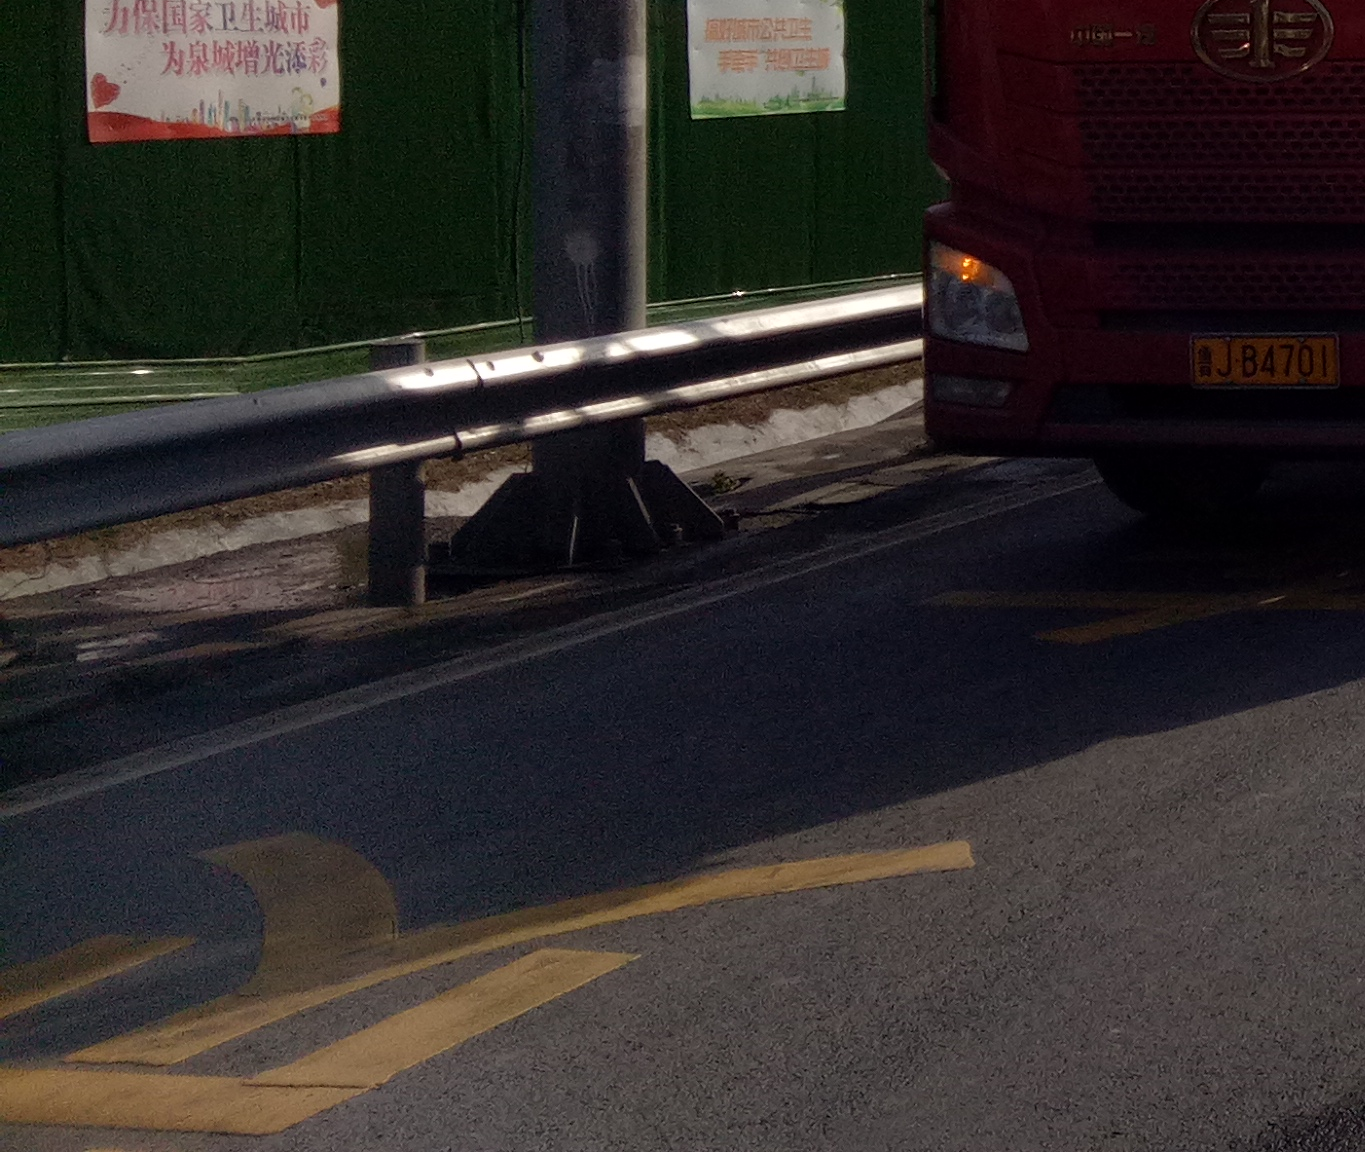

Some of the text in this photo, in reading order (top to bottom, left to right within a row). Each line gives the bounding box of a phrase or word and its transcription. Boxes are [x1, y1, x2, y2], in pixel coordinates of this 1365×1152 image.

[160, 35, 330, 77] 为泉城增光添彩
